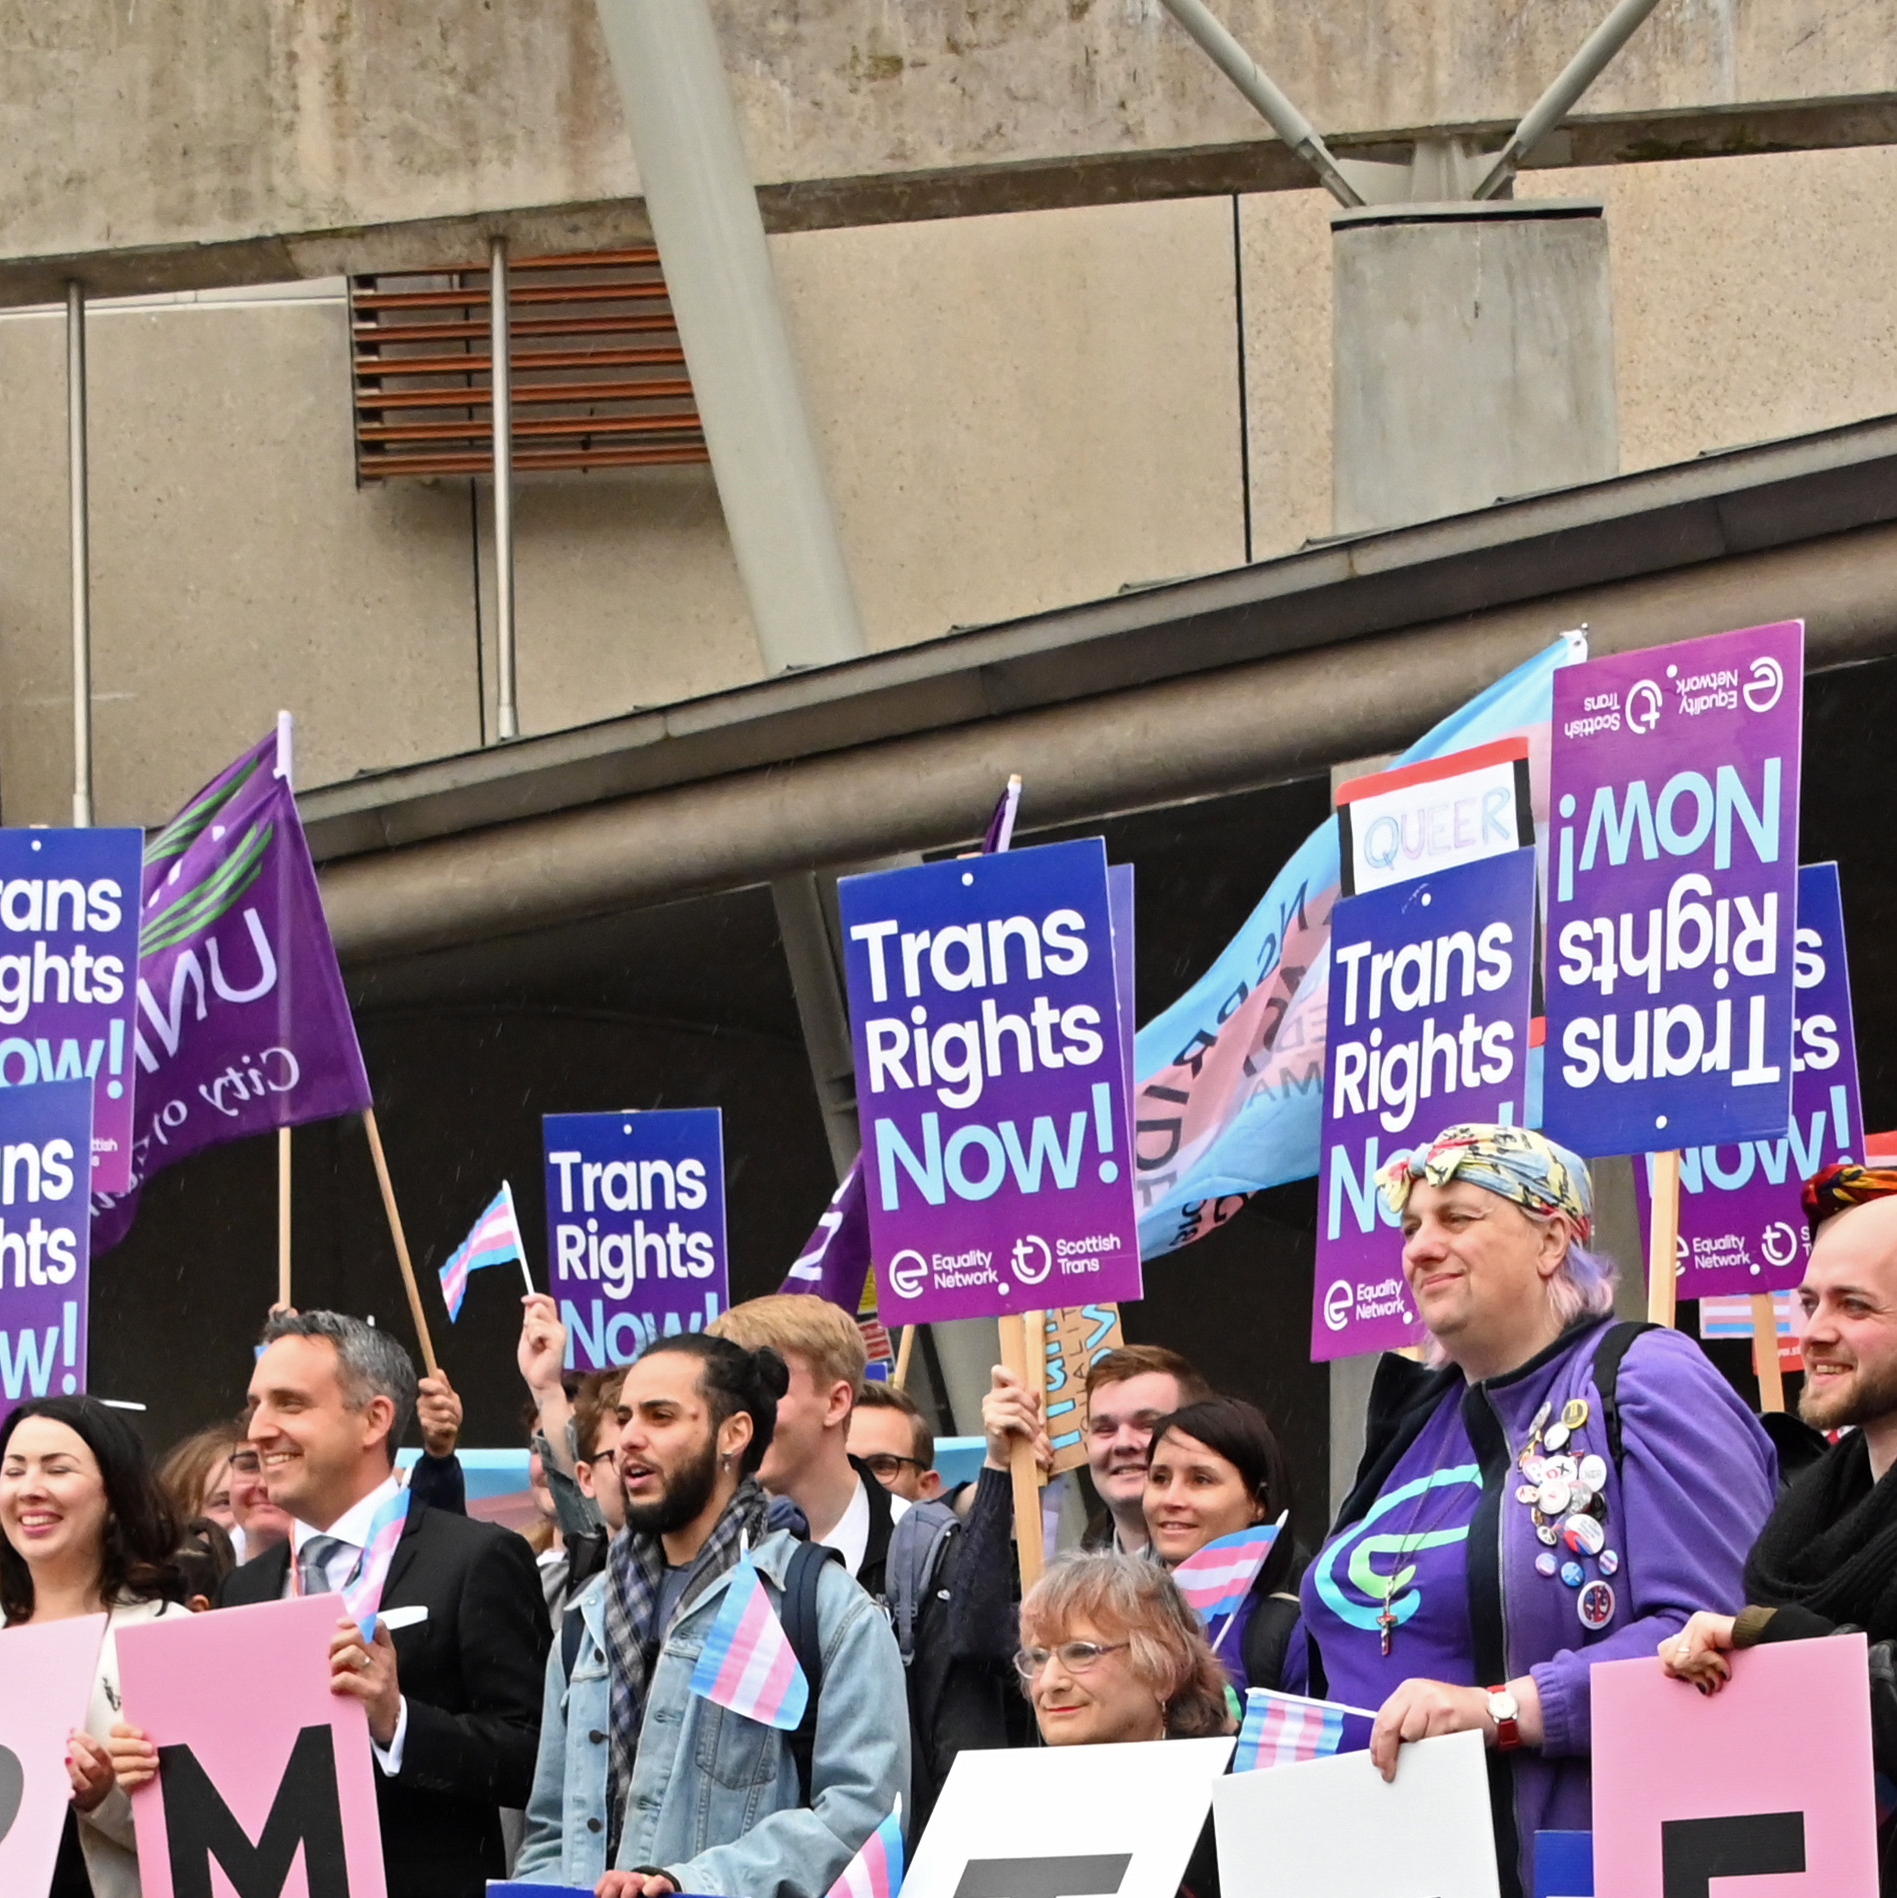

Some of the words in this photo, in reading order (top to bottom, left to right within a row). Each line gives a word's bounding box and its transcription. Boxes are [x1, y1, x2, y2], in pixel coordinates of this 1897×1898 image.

[1676, 669, 1739, 694] Network
[1584, 691, 1621, 712] Trans
[1679, 689, 1739, 714] Equality
[1564, 711, 1621, 740] Scottish
[1364, 785, 1511, 871] QUEER
[1557, 757, 1782, 902] Now!
[1558, 873, 1779, 996] Rights
[850, 909, 1089, 1003] Trans
[1335, 921, 1513, 1026] Trans
[865, 996, 1104, 1110] Rights
[1562, 995, 1781, 1088] Trans
[1332, 1012, 1514, 1133] Rights
[874, 1083, 1119, 1211] Now!
[549, 1151, 707, 1212] Trans
[556, 1218, 715, 1300] Rights
[1055, 1233, 1121, 1256] Scottish
[1692, 1235, 1745, 1254] Equality
[1694, 1248, 1750, 1267] Network
[932, 1250, 993, 1274] Equality
[1058, 1256, 1100, 1275] Trans
[934, 1268, 999, 1290] Network
[1356, 1281, 1402, 1302] Equality
[1355, 1297, 1405, 1318] Network
